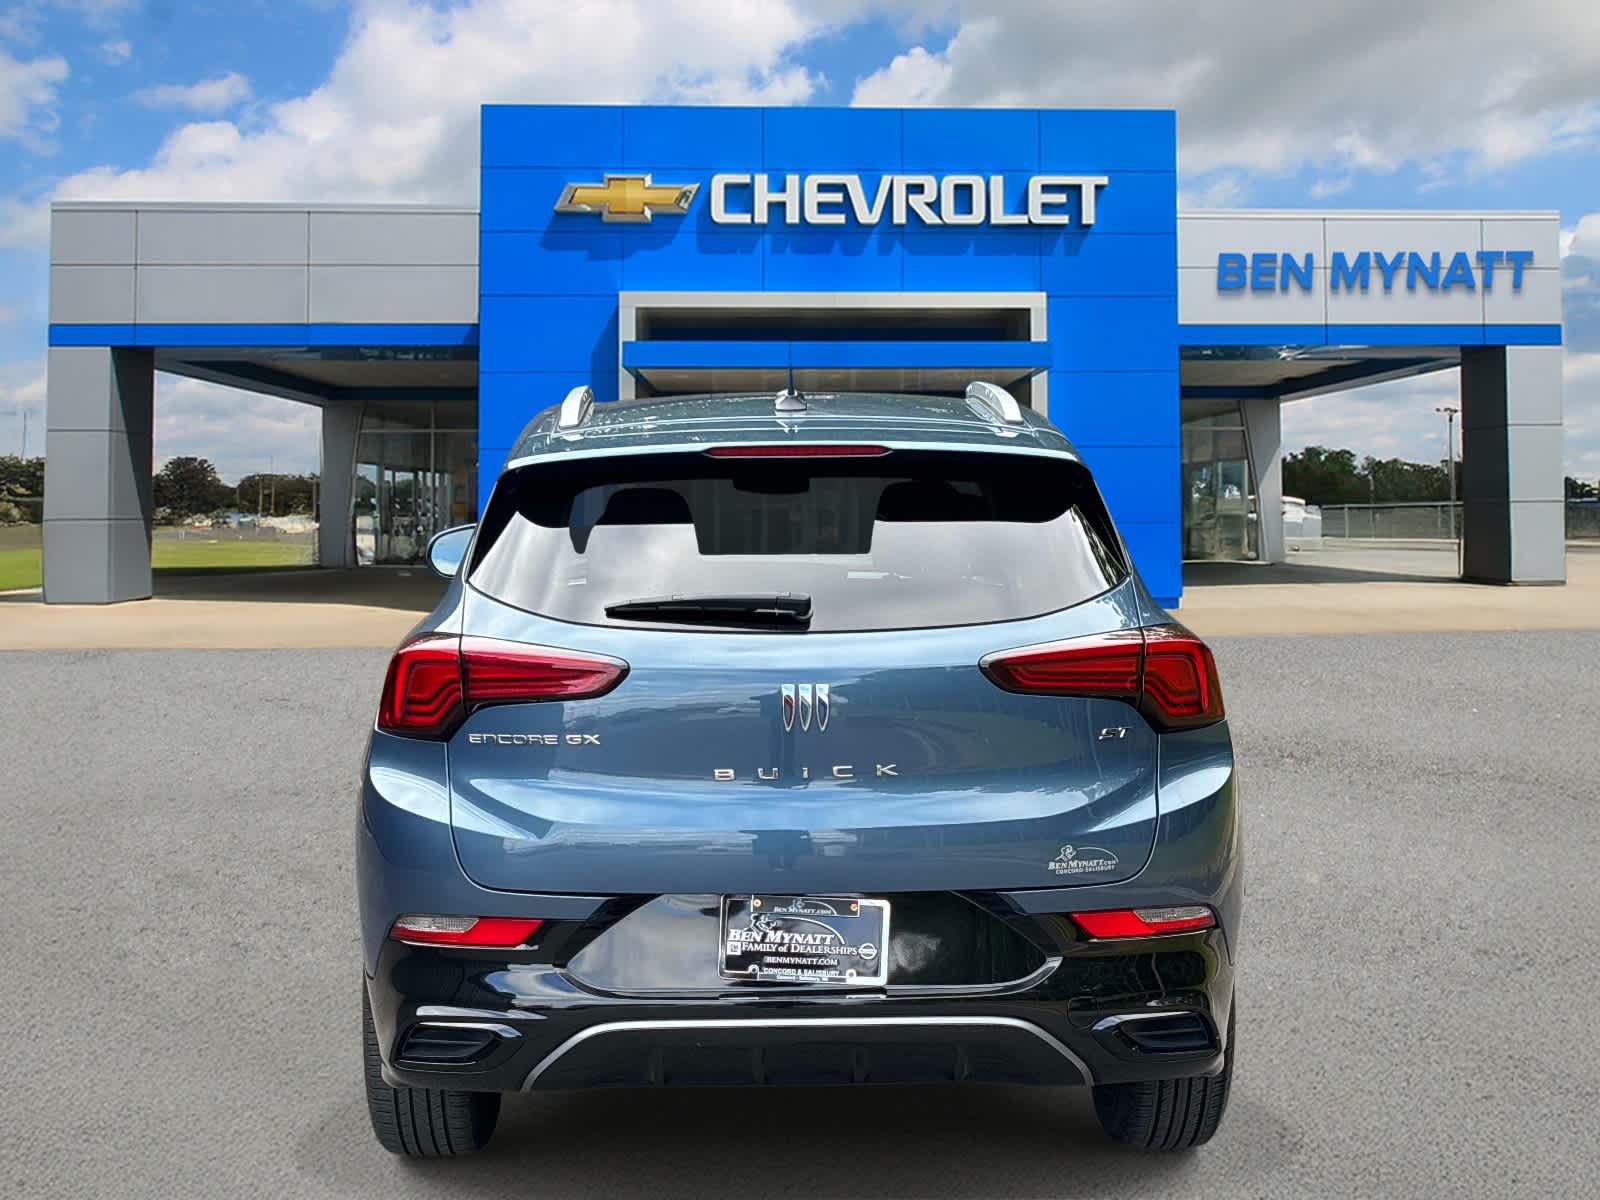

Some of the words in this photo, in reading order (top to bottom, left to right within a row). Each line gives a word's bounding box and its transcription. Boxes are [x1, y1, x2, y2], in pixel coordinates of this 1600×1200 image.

[710, 174, 1109, 226] CHEVROLET
[1216, 251, 1313, 292] BEN
[1330, 249, 1534, 292] MYNATT
[468, 733, 558, 744] ENCORE
[565, 734, 600, 745] GX
[713, 763, 899, 781] BUICK
[728, 929, 763, 942] BEN
[765, 930, 835, 945] MYNATT
[742, 942, 777, 952] FAMILY
[778, 945, 788, 953] of
[791, 944, 858, 956] DEALERSHIPS
